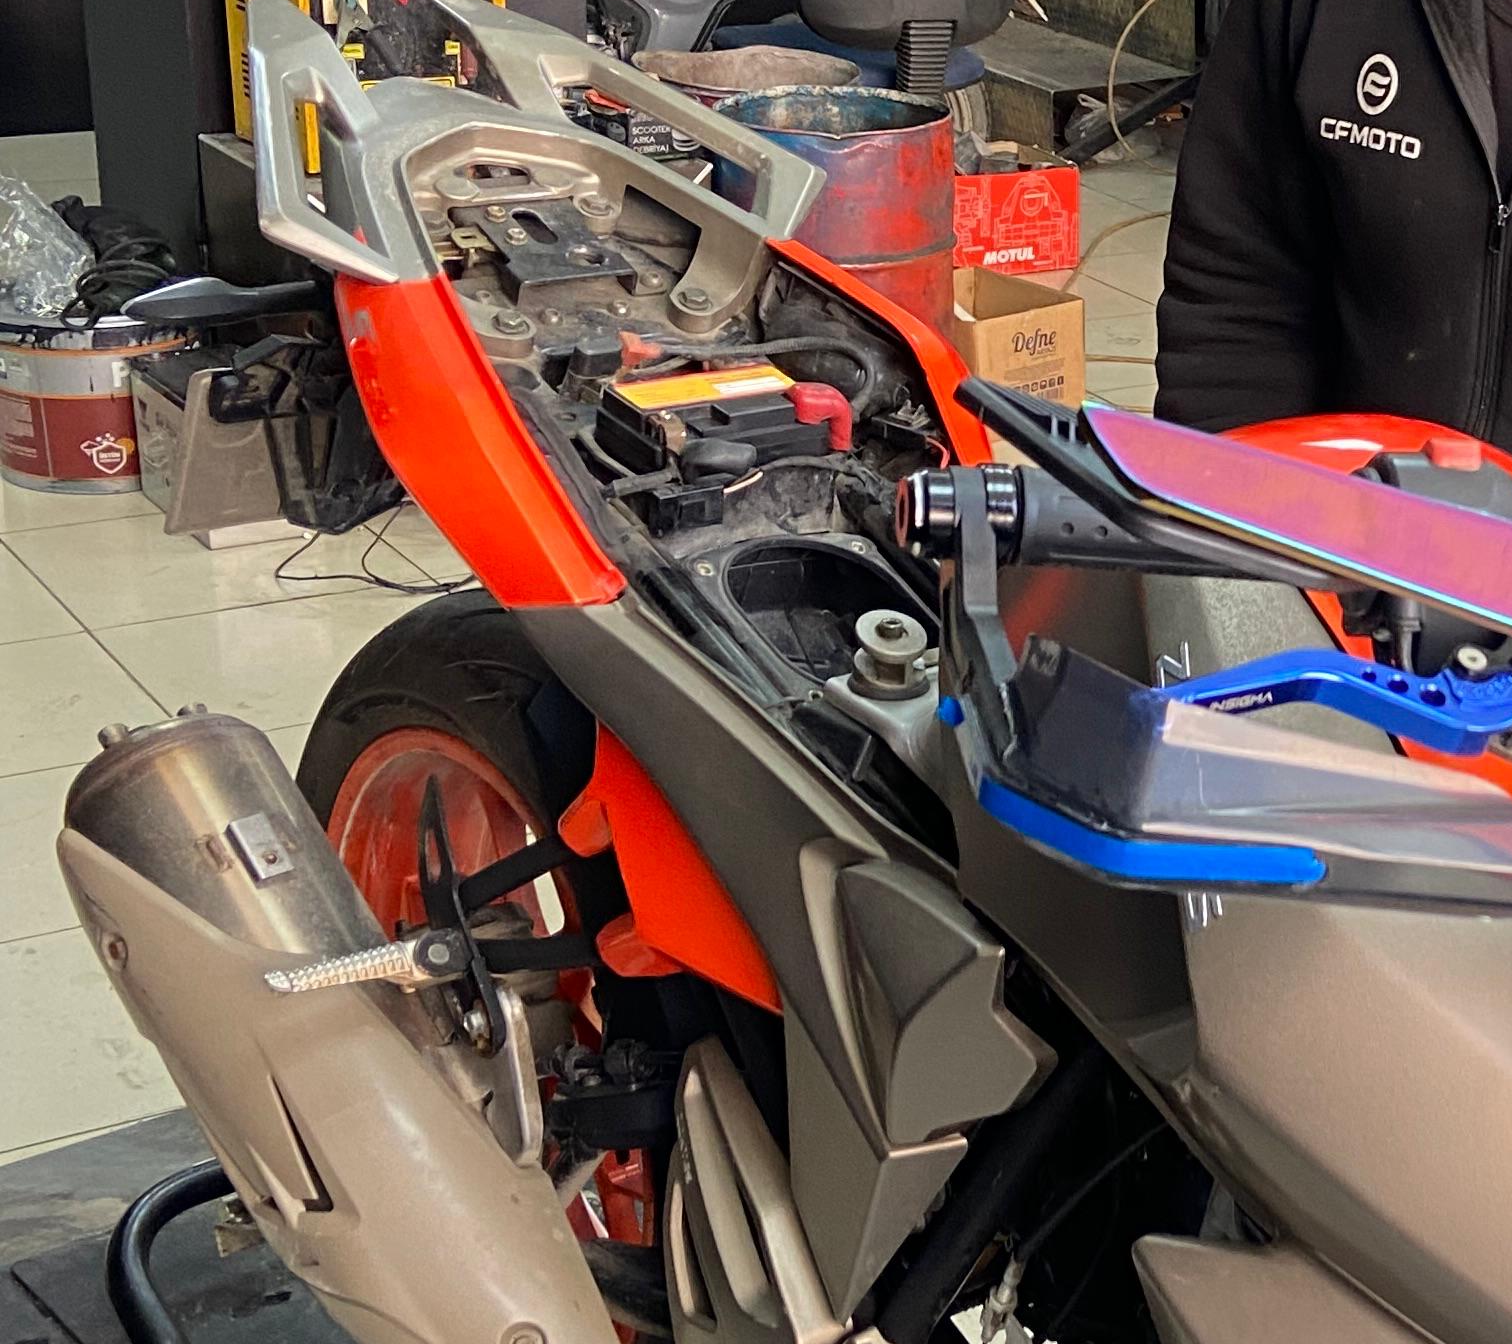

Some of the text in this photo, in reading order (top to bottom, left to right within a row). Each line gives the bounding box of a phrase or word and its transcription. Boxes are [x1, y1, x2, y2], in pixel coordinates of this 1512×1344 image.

[1319, 116, 1422, 160] CFMOTO
[982, 246, 1036, 265] MOTUL
[1011, 327, 1057, 356] Defne
